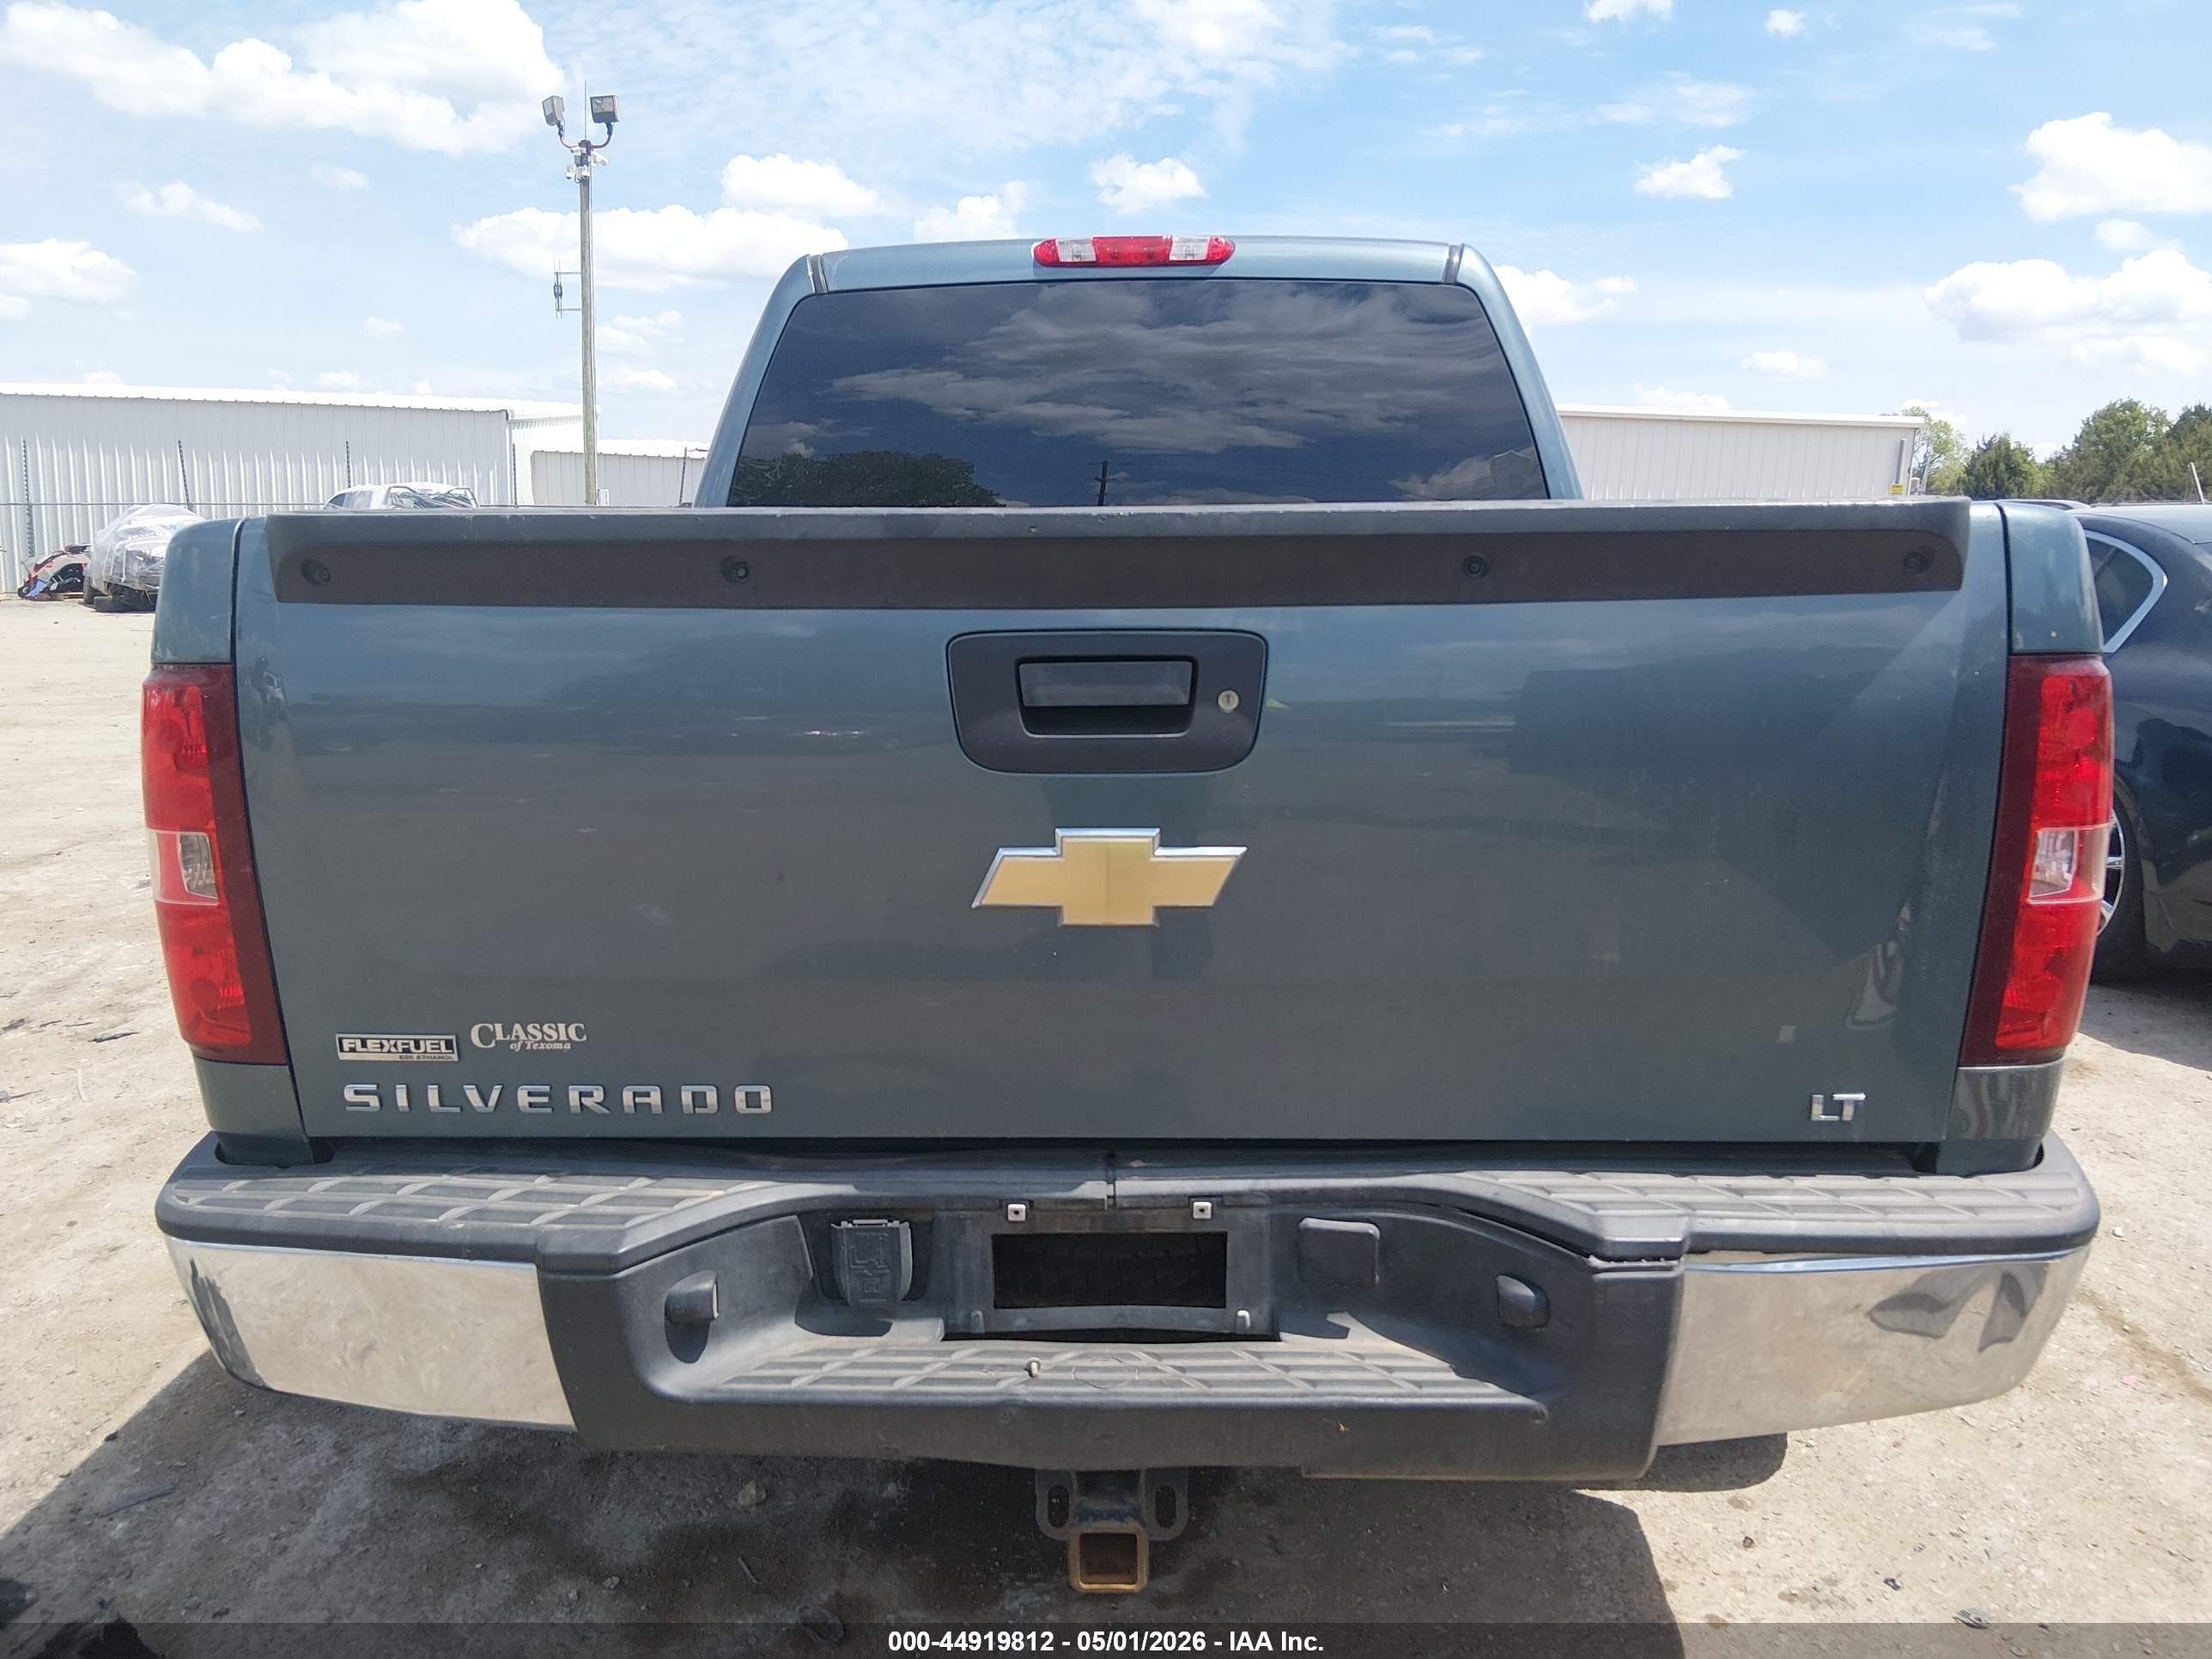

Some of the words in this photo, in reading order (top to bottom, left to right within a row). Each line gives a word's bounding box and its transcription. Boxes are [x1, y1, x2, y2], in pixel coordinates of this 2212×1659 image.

[343, 1038, 453, 1054] FLEXFUEL
[471, 1023, 587, 1048] CLASSIC
[509, 1041, 524, 1052] of
[525, 1040, 571, 1051] Texoma
[343, 1084, 773, 1115] SILVERADO
[1810, 1092, 1866, 1121] LT
